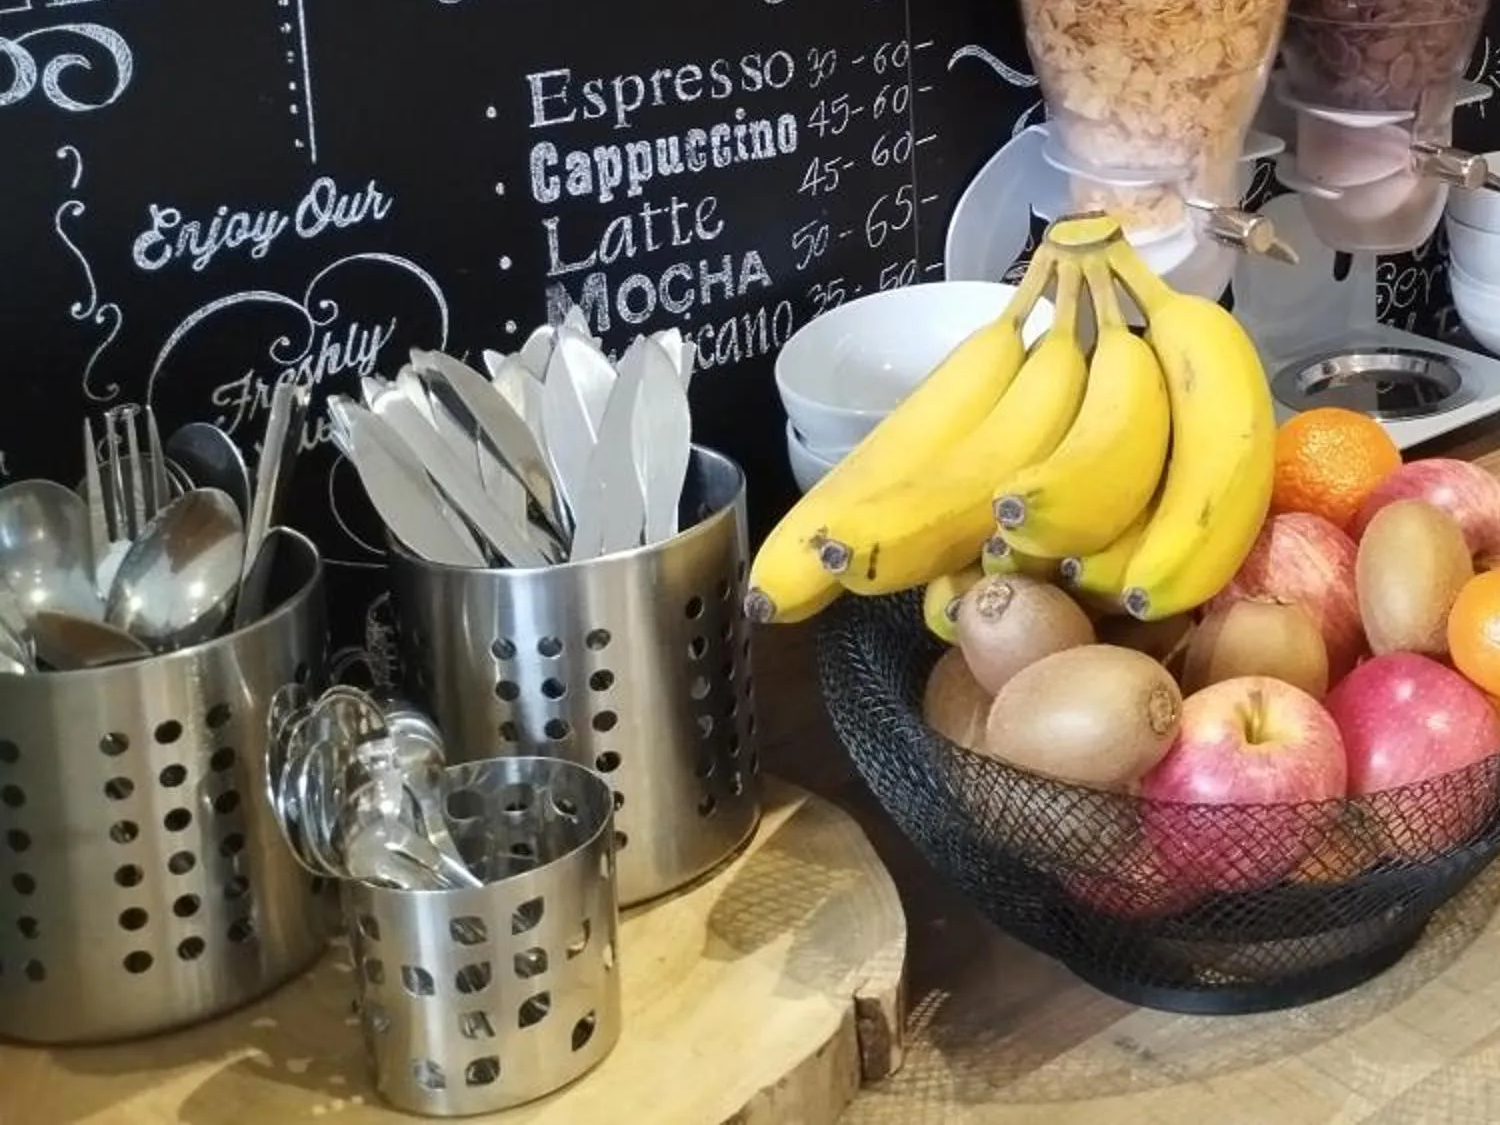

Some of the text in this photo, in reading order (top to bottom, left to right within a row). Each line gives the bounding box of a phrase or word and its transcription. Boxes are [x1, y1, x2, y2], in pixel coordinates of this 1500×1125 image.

[526, 49, 795, 129] Espresso
[530, 107, 798, 204] Cappuccino
[133, 176, 393, 271] Enjoy Our
[541, 195, 725, 275] Latte
[212, 317, 396, 436] Freshly
